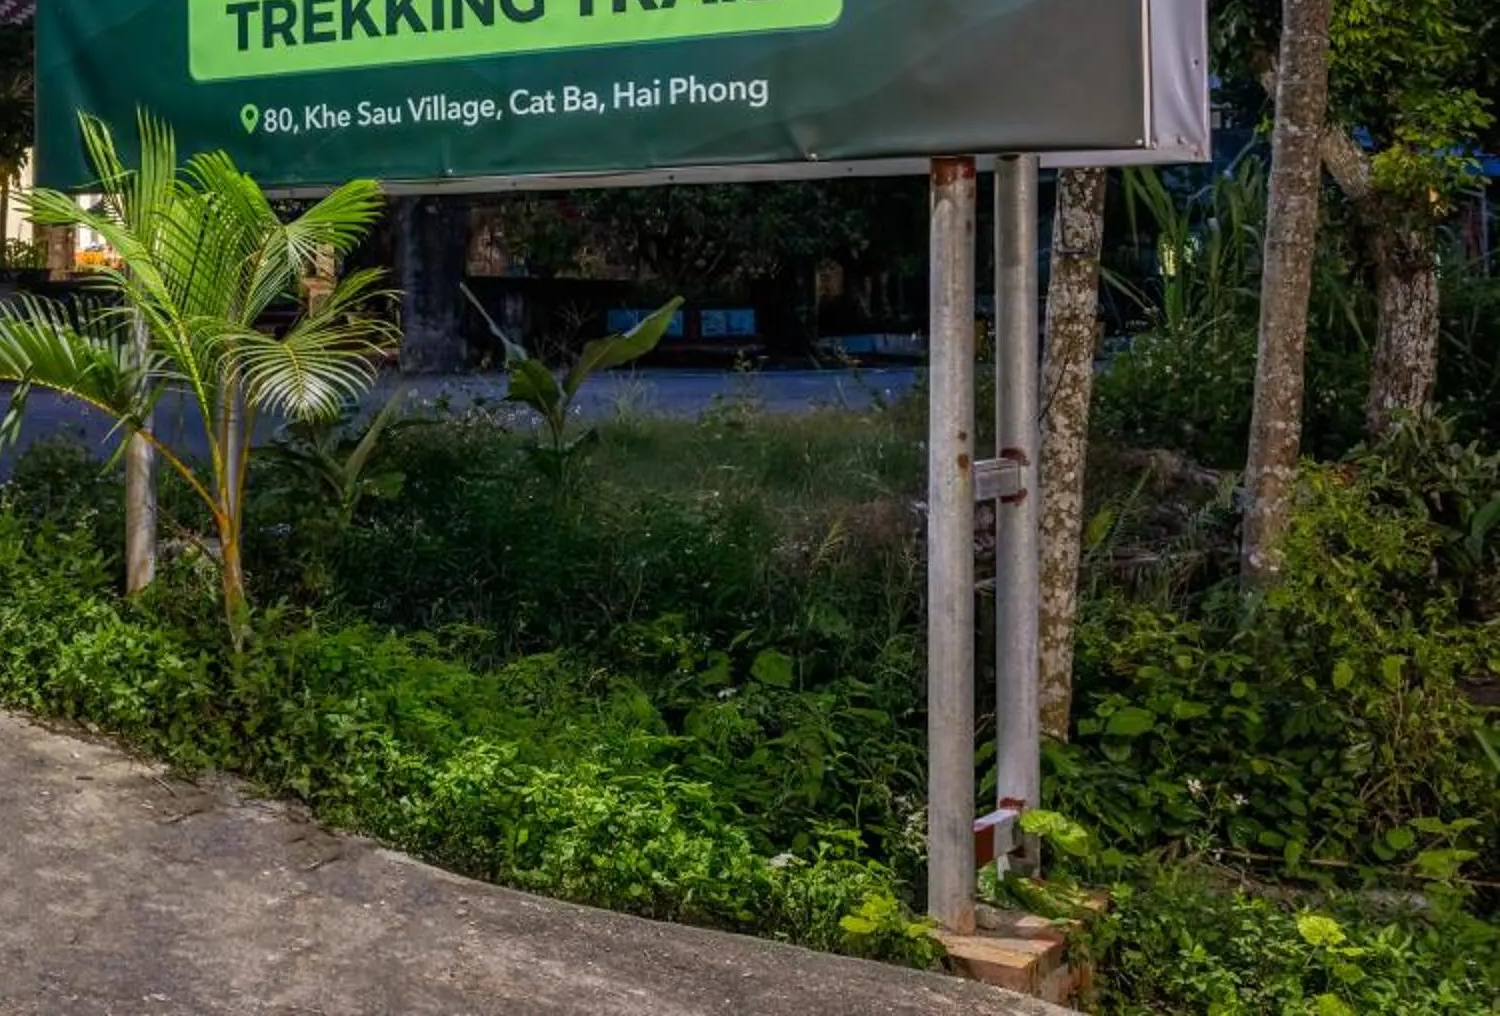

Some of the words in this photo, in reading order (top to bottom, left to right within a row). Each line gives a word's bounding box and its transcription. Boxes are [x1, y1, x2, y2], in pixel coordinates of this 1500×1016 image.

[263, 106, 300, 134] 80,
[304, 101, 352, 131] Khe
[357, 100, 402, 126] Sau
[406, 92, 503, 128] Village,
[508, 89, 555, 115] Cat
[562, 86, 606, 114] Ba,
[613, 77, 661, 108] Hai
[669, 74, 770, 109] Phong
